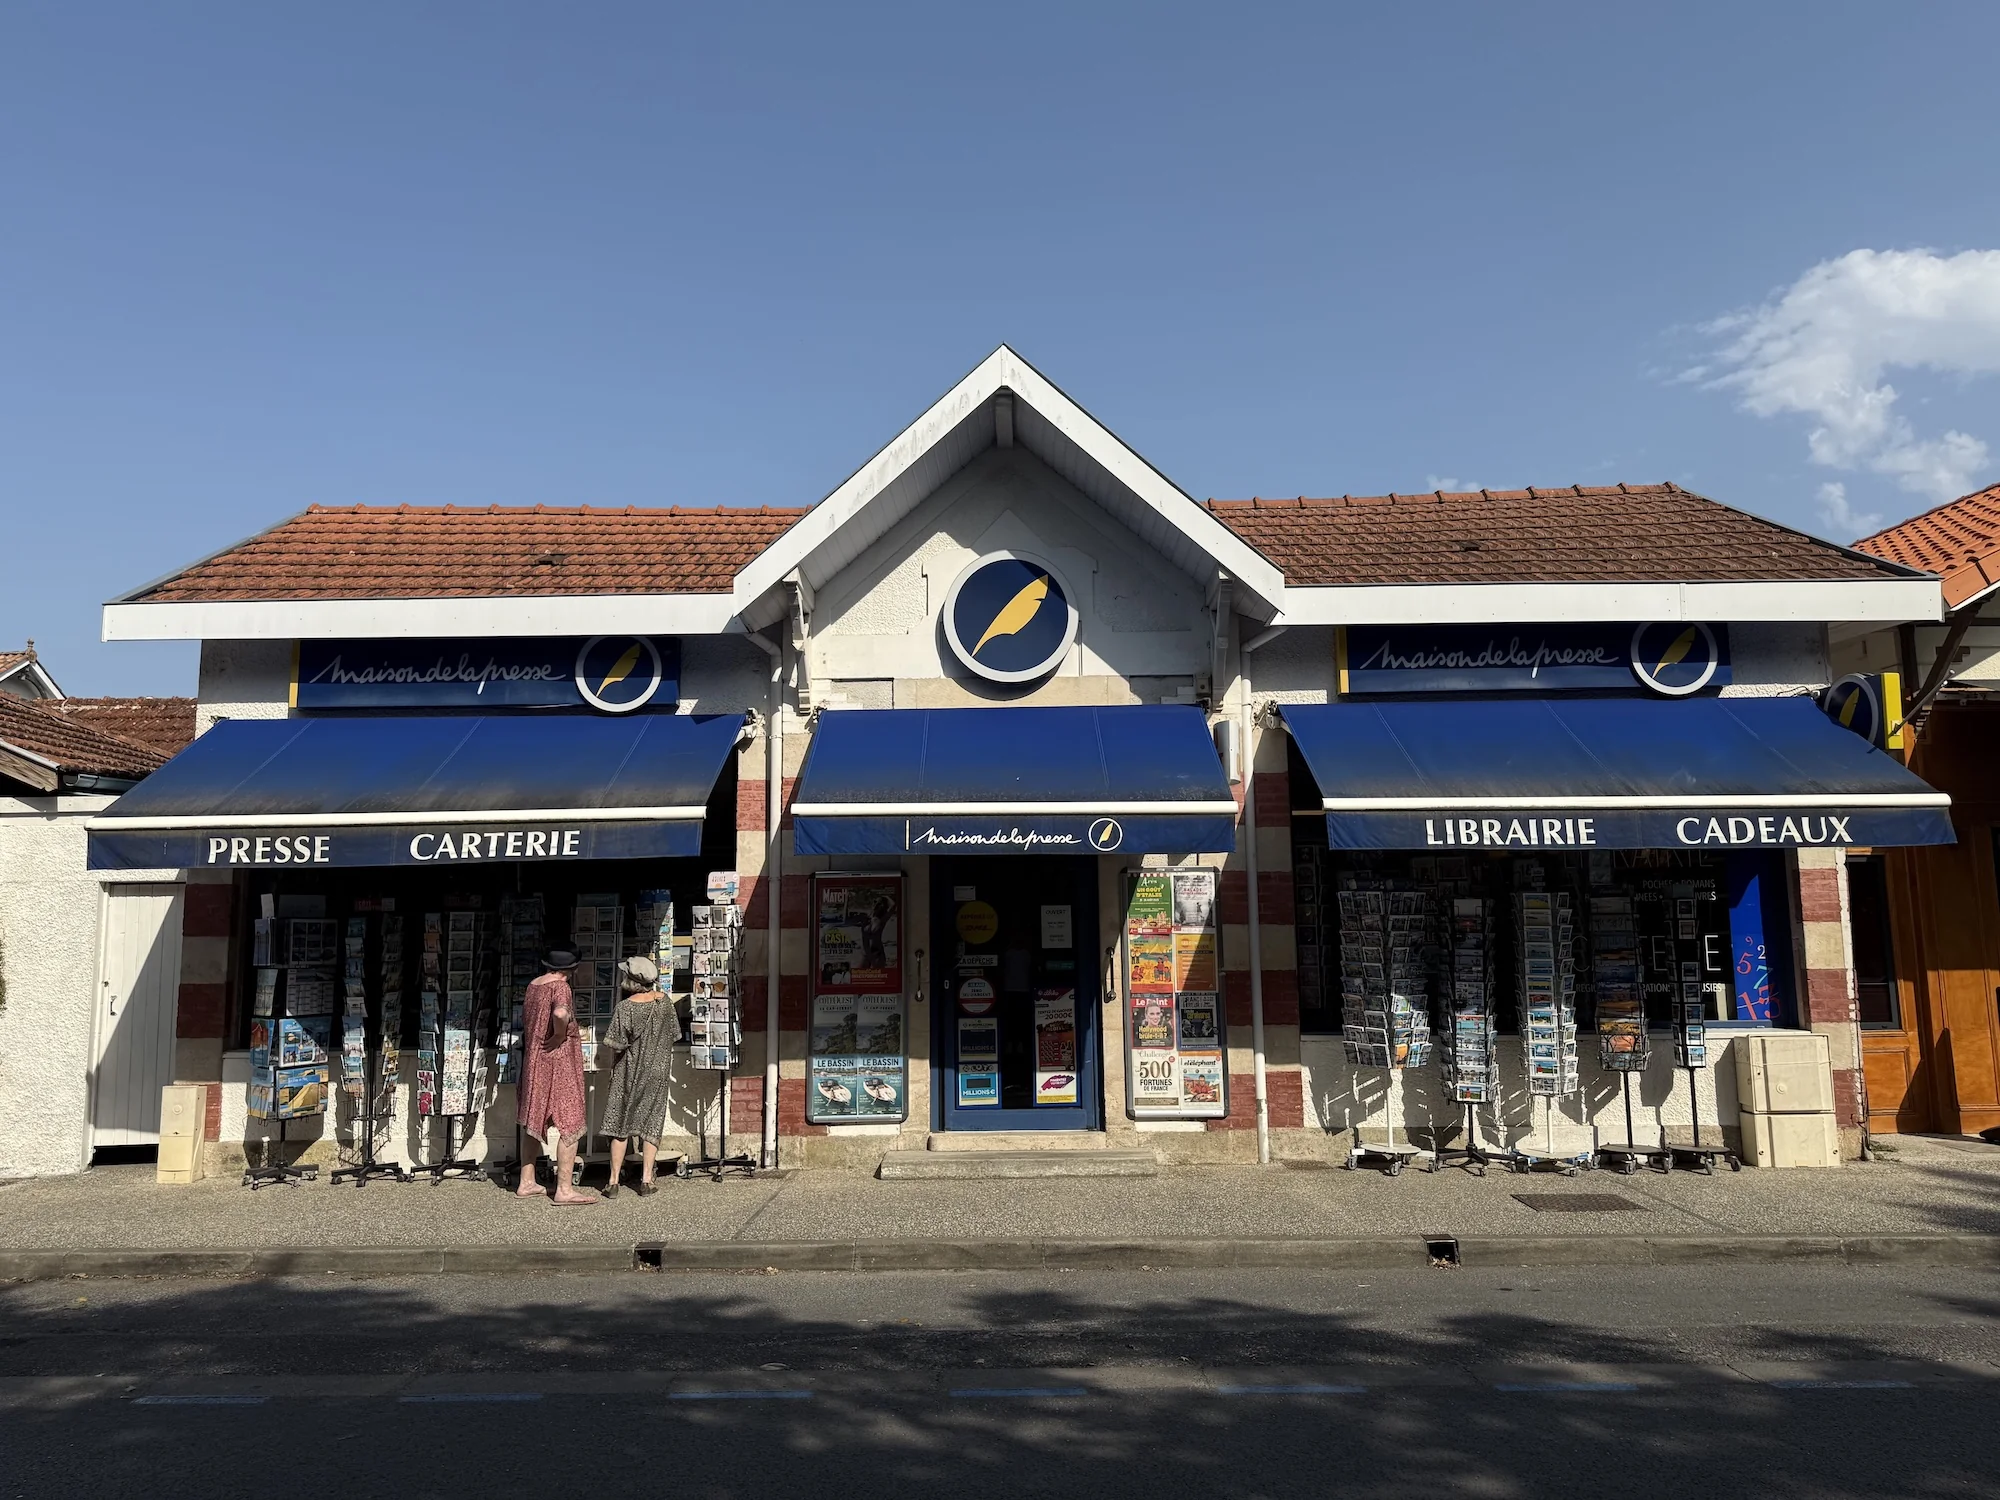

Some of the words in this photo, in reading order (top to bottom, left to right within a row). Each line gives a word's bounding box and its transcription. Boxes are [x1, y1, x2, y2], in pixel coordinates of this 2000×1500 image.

[1425, 817, 1597, 847] LIBRAIRIE
[1677, 815, 1854, 846] CADEAUX
[207, 834, 331, 865] PRESSE
[409, 829, 581, 861] CARTERIE
[1757, 944, 1766, 959] 2
[1736, 952, 1754, 975] 5
[1753, 964, 1773, 989] 7
[1138, 1026, 1168, 1035] Hollywood
[828, 1059, 854, 1067] BASSIN
[862, 1059, 871, 1067] LE
[1139, 1061, 1172, 1078] 500
